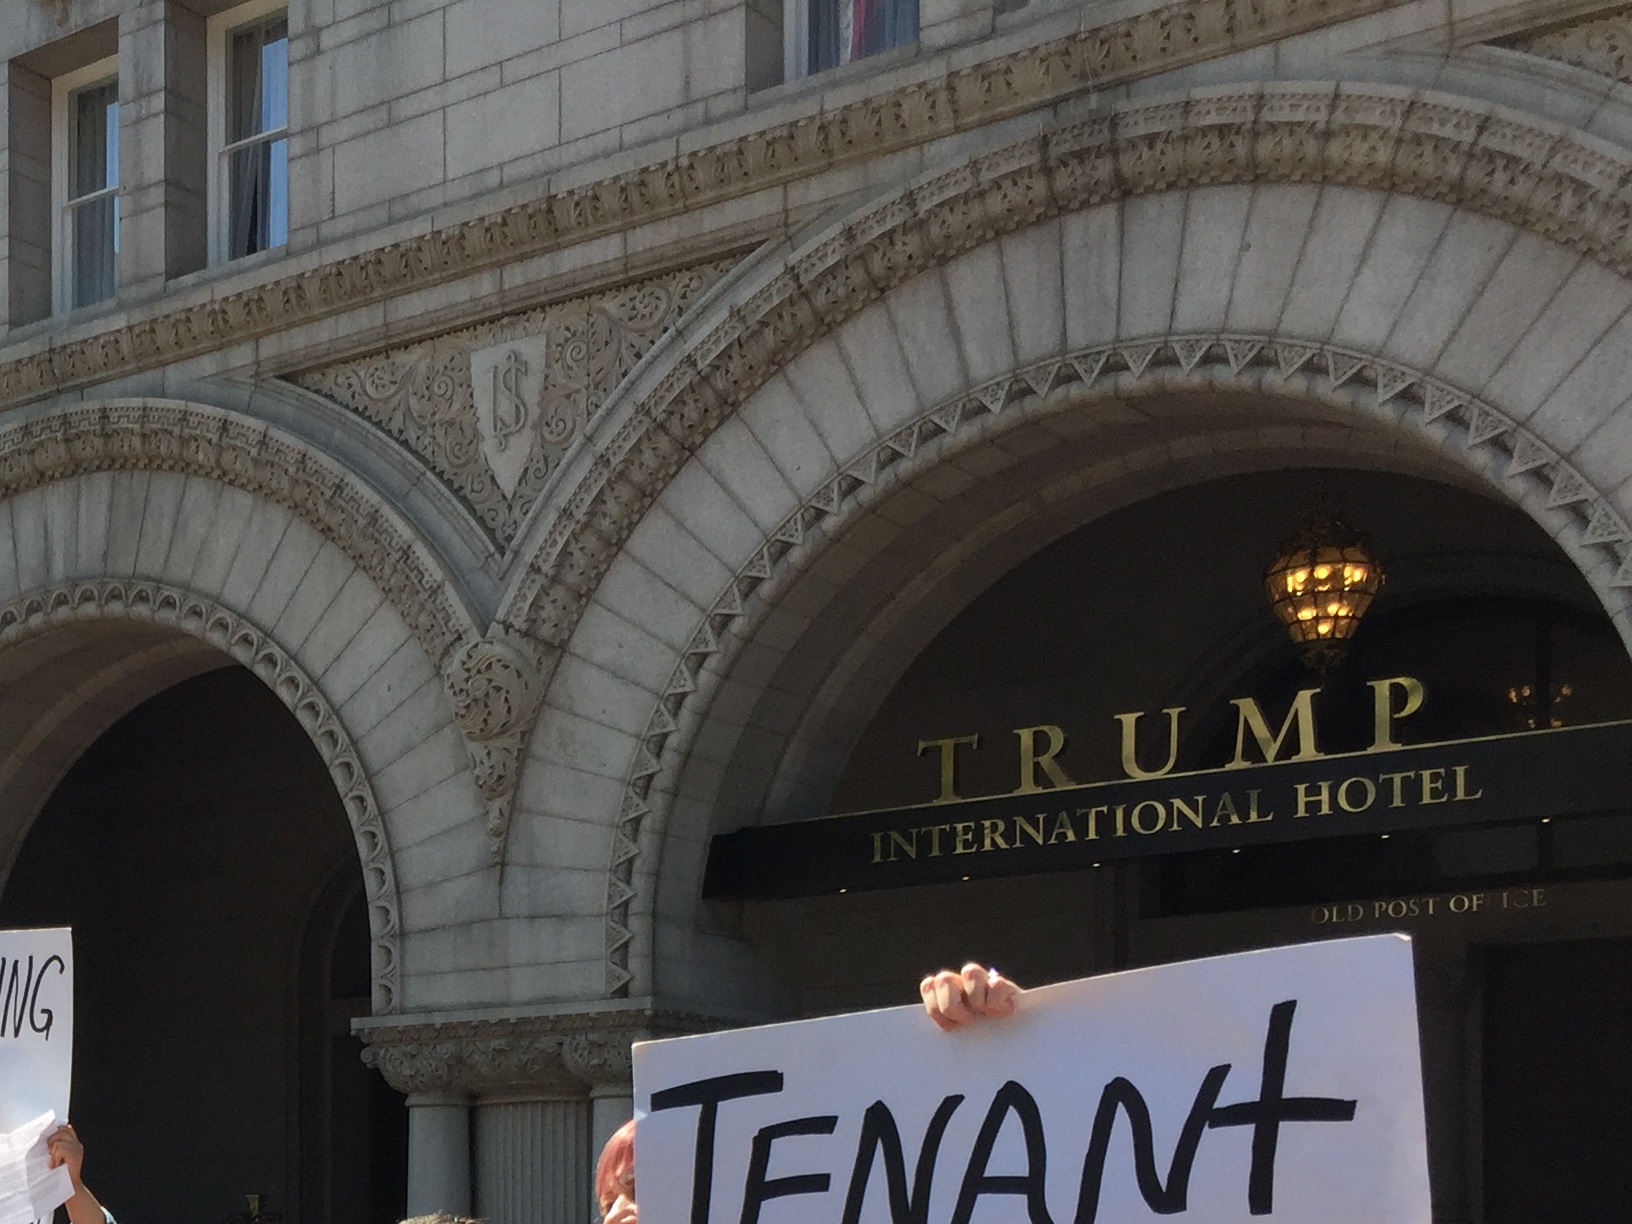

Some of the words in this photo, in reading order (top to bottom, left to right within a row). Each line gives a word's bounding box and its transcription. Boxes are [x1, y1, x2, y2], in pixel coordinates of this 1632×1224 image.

[917, 676, 1426, 805] TRUMP
[870, 788, 1274, 864] INTERNATIONAL
[1294, 765, 1484, 819] HOTEL
[1311, 904, 1364, 924] OLD
[1374, 898, 1440, 919] POST
[1449, 889, 1547, 913] OFICE
